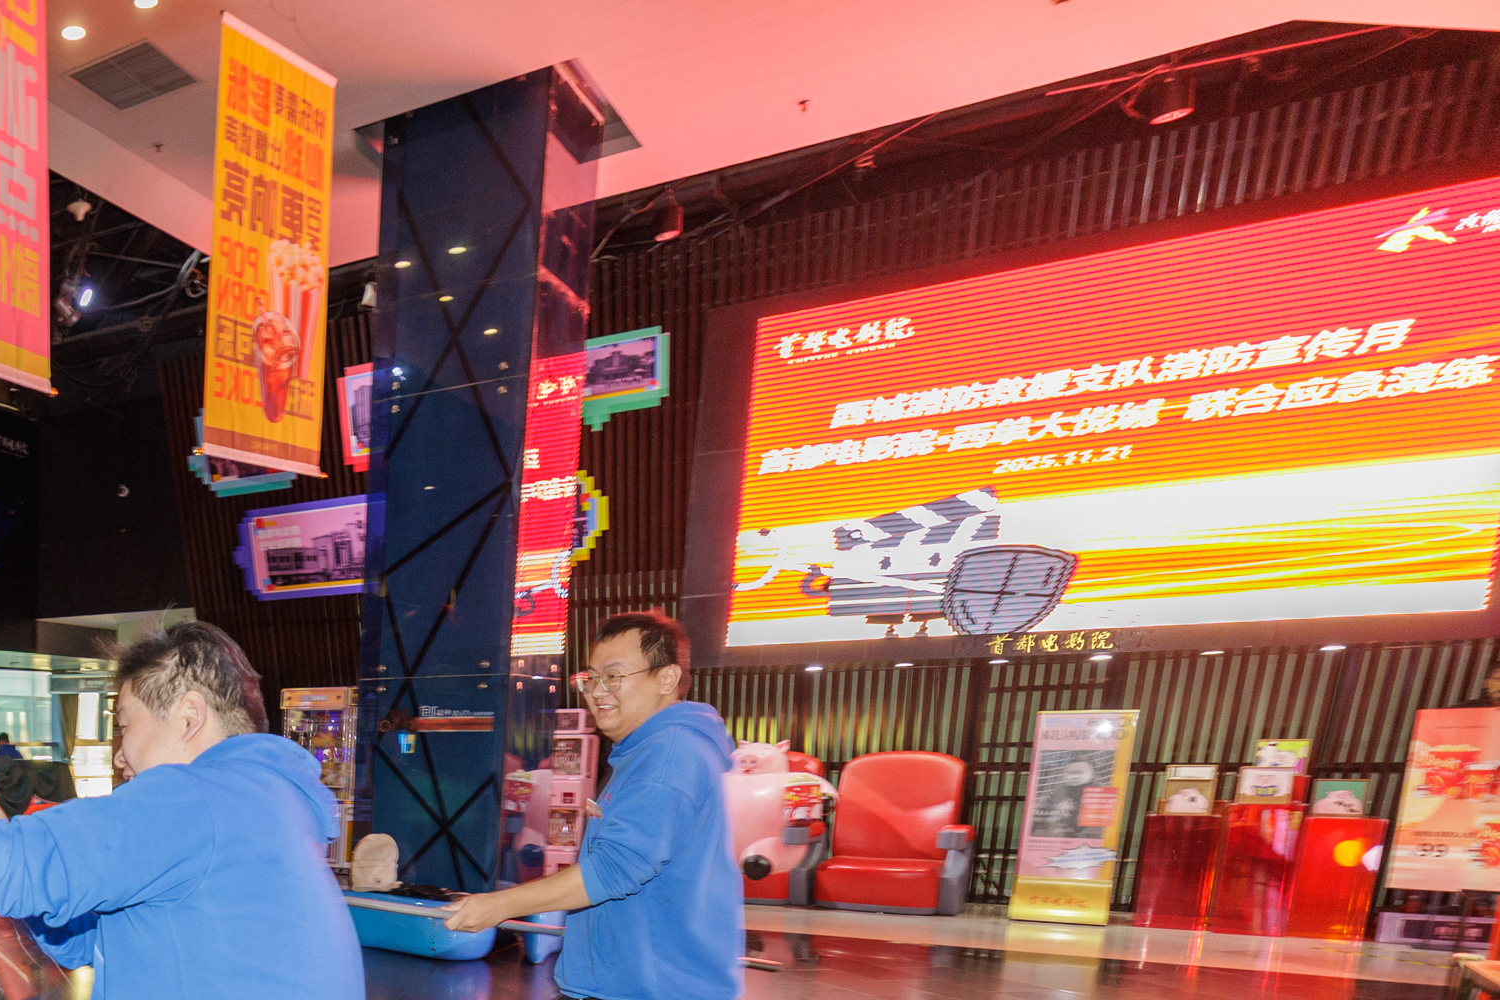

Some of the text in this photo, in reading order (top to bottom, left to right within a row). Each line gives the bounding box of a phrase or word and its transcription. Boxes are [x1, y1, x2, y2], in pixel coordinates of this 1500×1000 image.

[830, 318, 1415, 430] 西城消防救援支队消防宣传月
[1183, 356, 1500, 422] 联合应急演练
[984, 631, 1114, 655] 首都电影院
